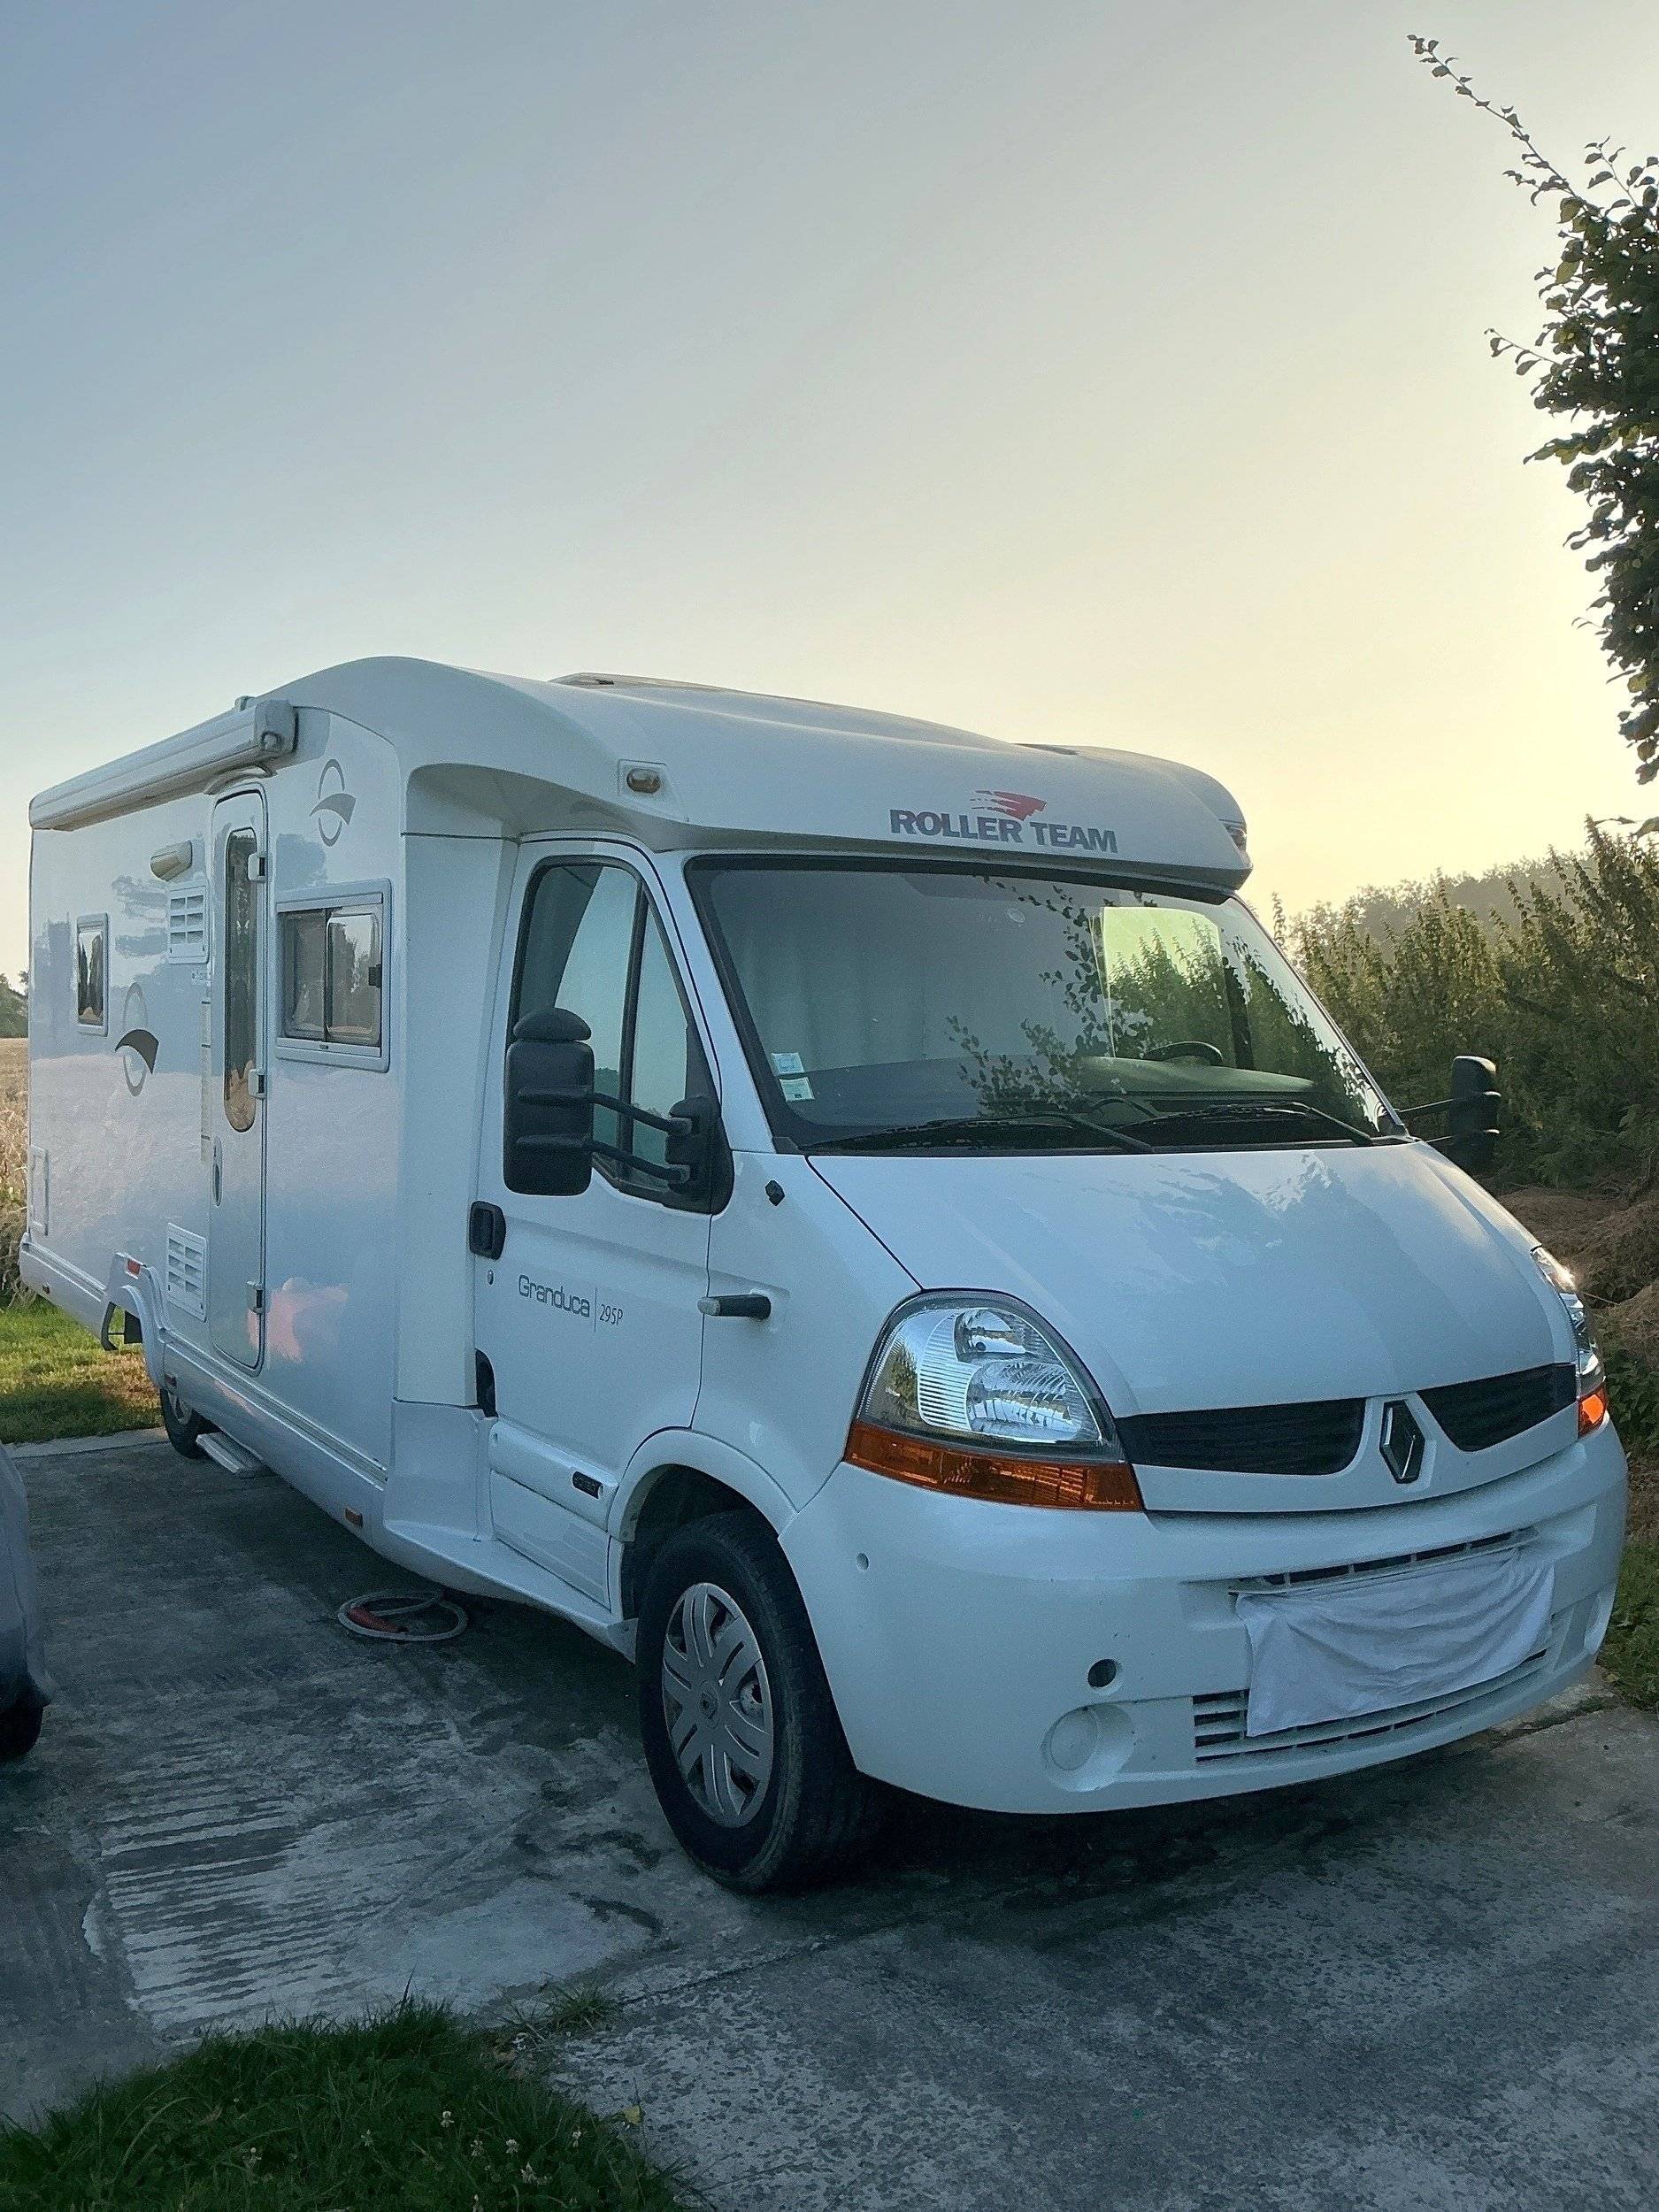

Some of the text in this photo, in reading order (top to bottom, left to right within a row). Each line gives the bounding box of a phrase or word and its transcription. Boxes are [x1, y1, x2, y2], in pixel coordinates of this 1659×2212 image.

[889, 809, 1118, 854] ROLLER TEAM
[518, 1274, 590, 1317] Granduca
